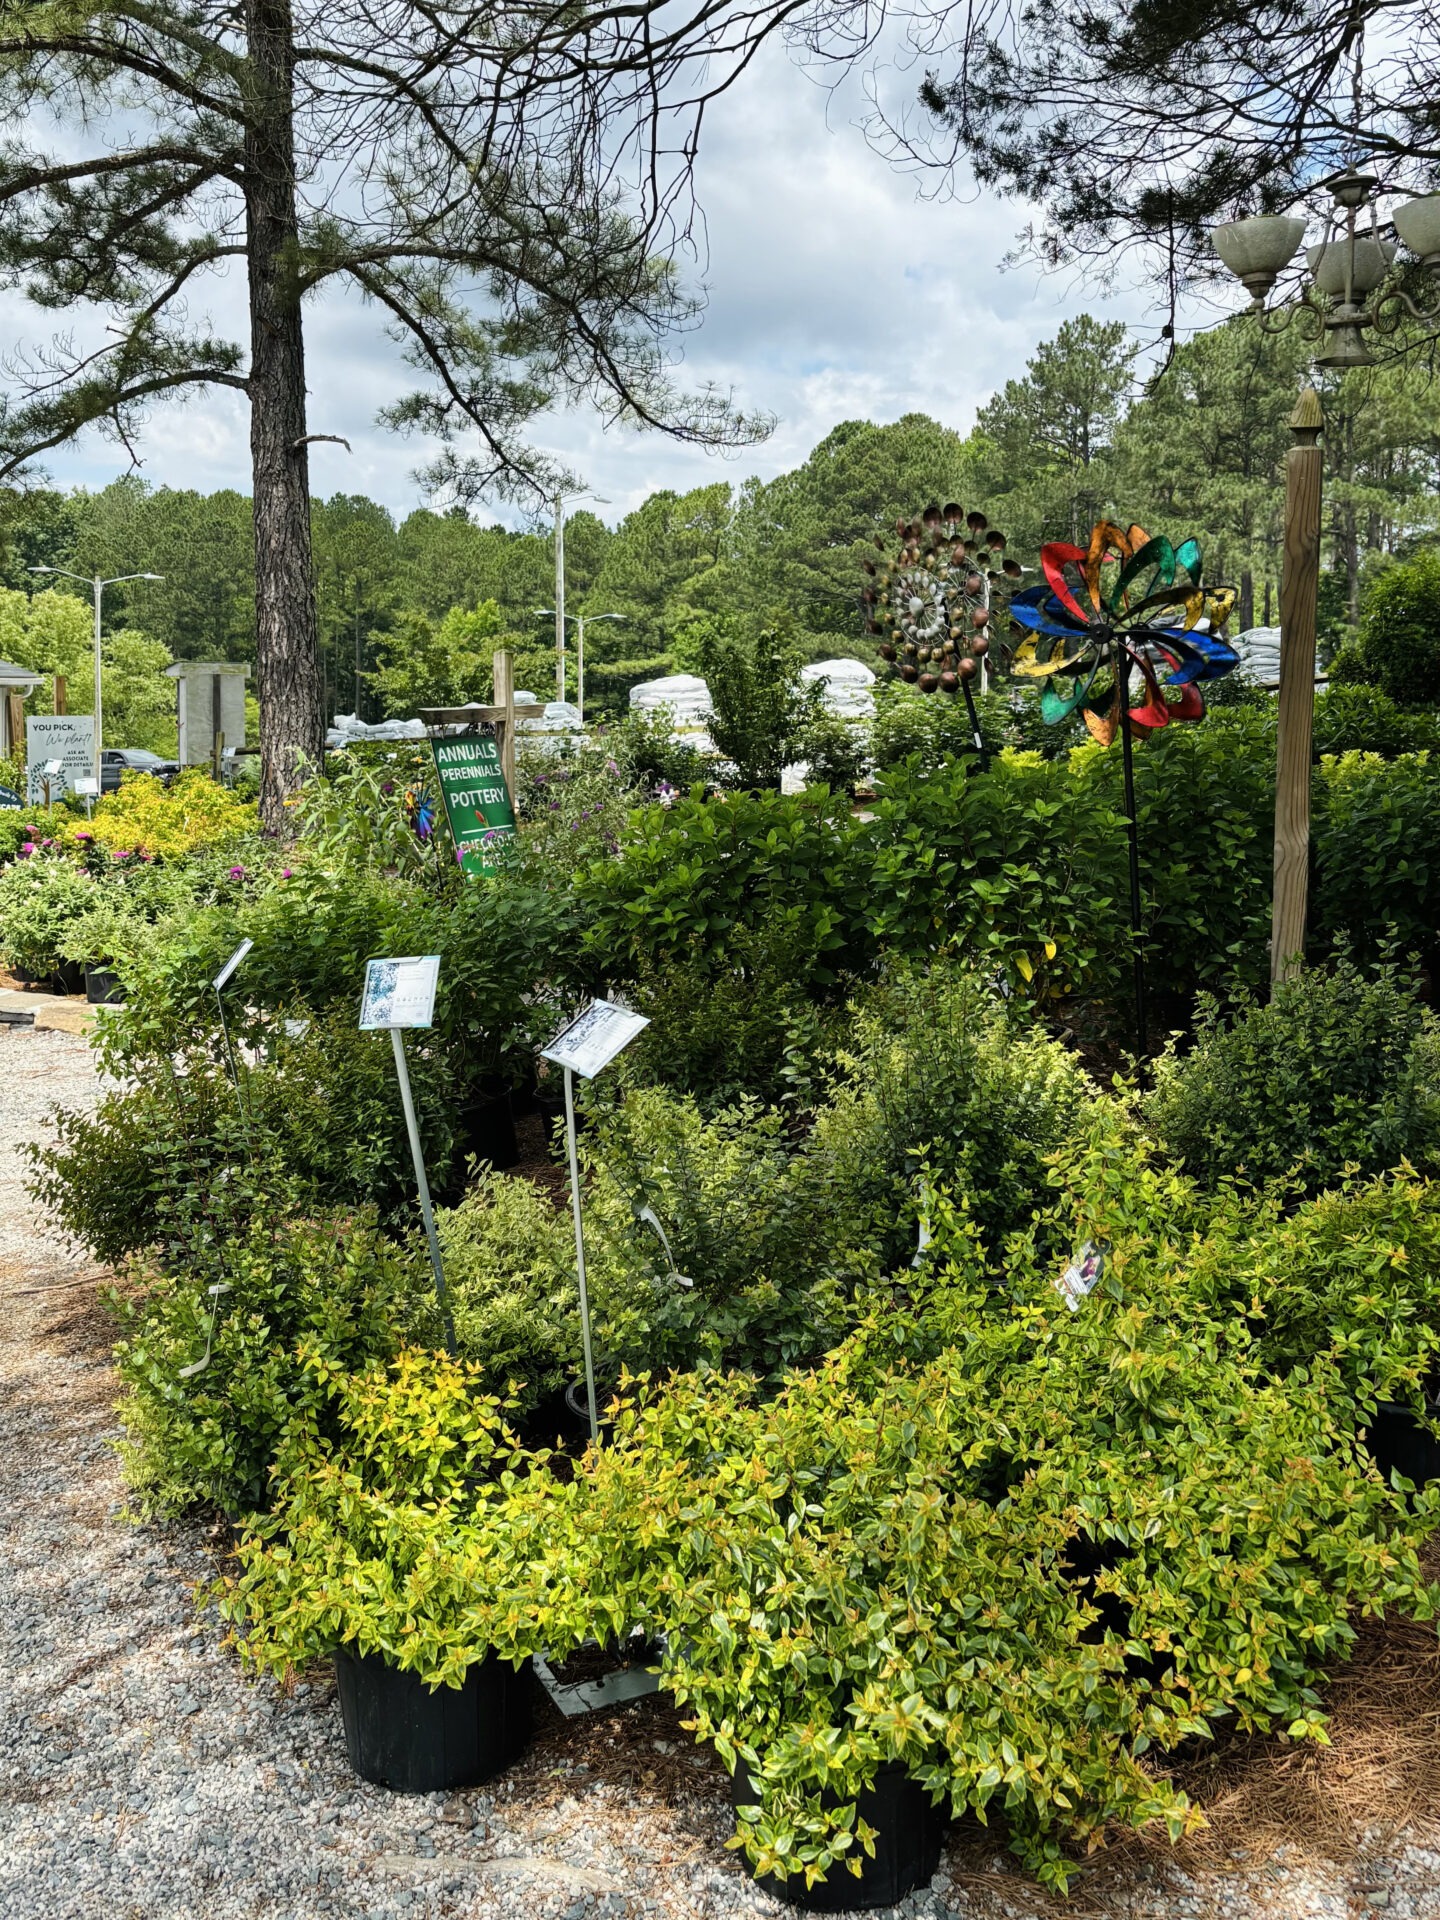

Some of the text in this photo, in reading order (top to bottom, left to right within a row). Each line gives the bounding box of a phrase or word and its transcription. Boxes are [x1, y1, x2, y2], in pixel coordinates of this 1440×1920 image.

[46, 733, 62, 746] We
[438, 743, 497, 763] ANNUALS
[441, 764, 501, 781] PERENNIALS
[450, 787, 505, 809] POTTERY
